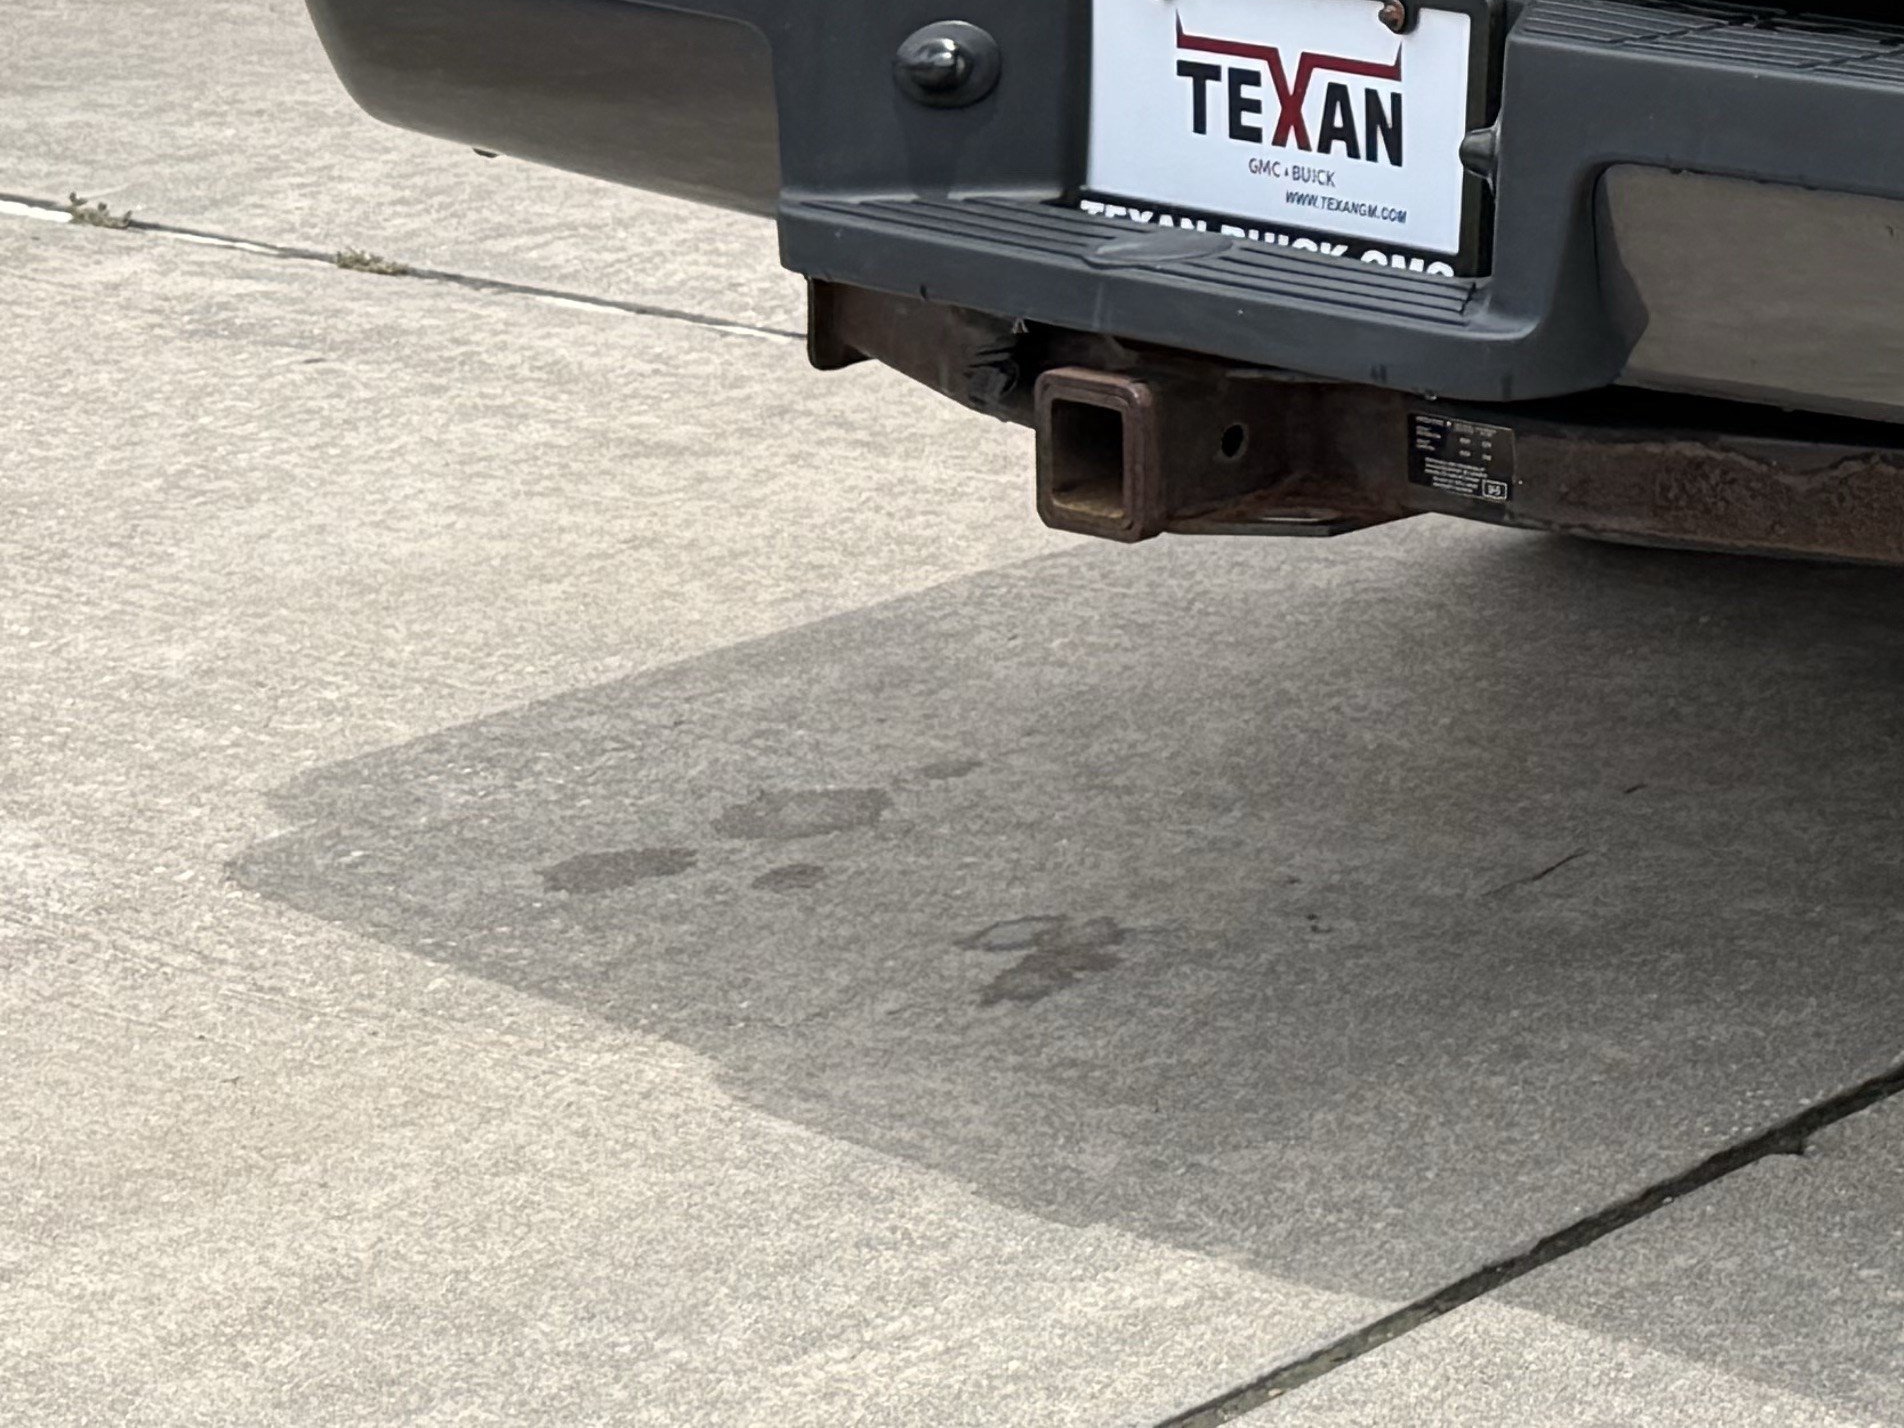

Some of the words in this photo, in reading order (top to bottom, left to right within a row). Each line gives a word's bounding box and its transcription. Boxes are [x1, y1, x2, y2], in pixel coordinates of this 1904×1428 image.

[1176, 26, 1403, 168] TEXAN
[1248, 157, 1282, 178] GMC
[1291, 164, 1336, 187] BUICK
[1285, 190, 1408, 224] WWW.TEXANGM.COM
